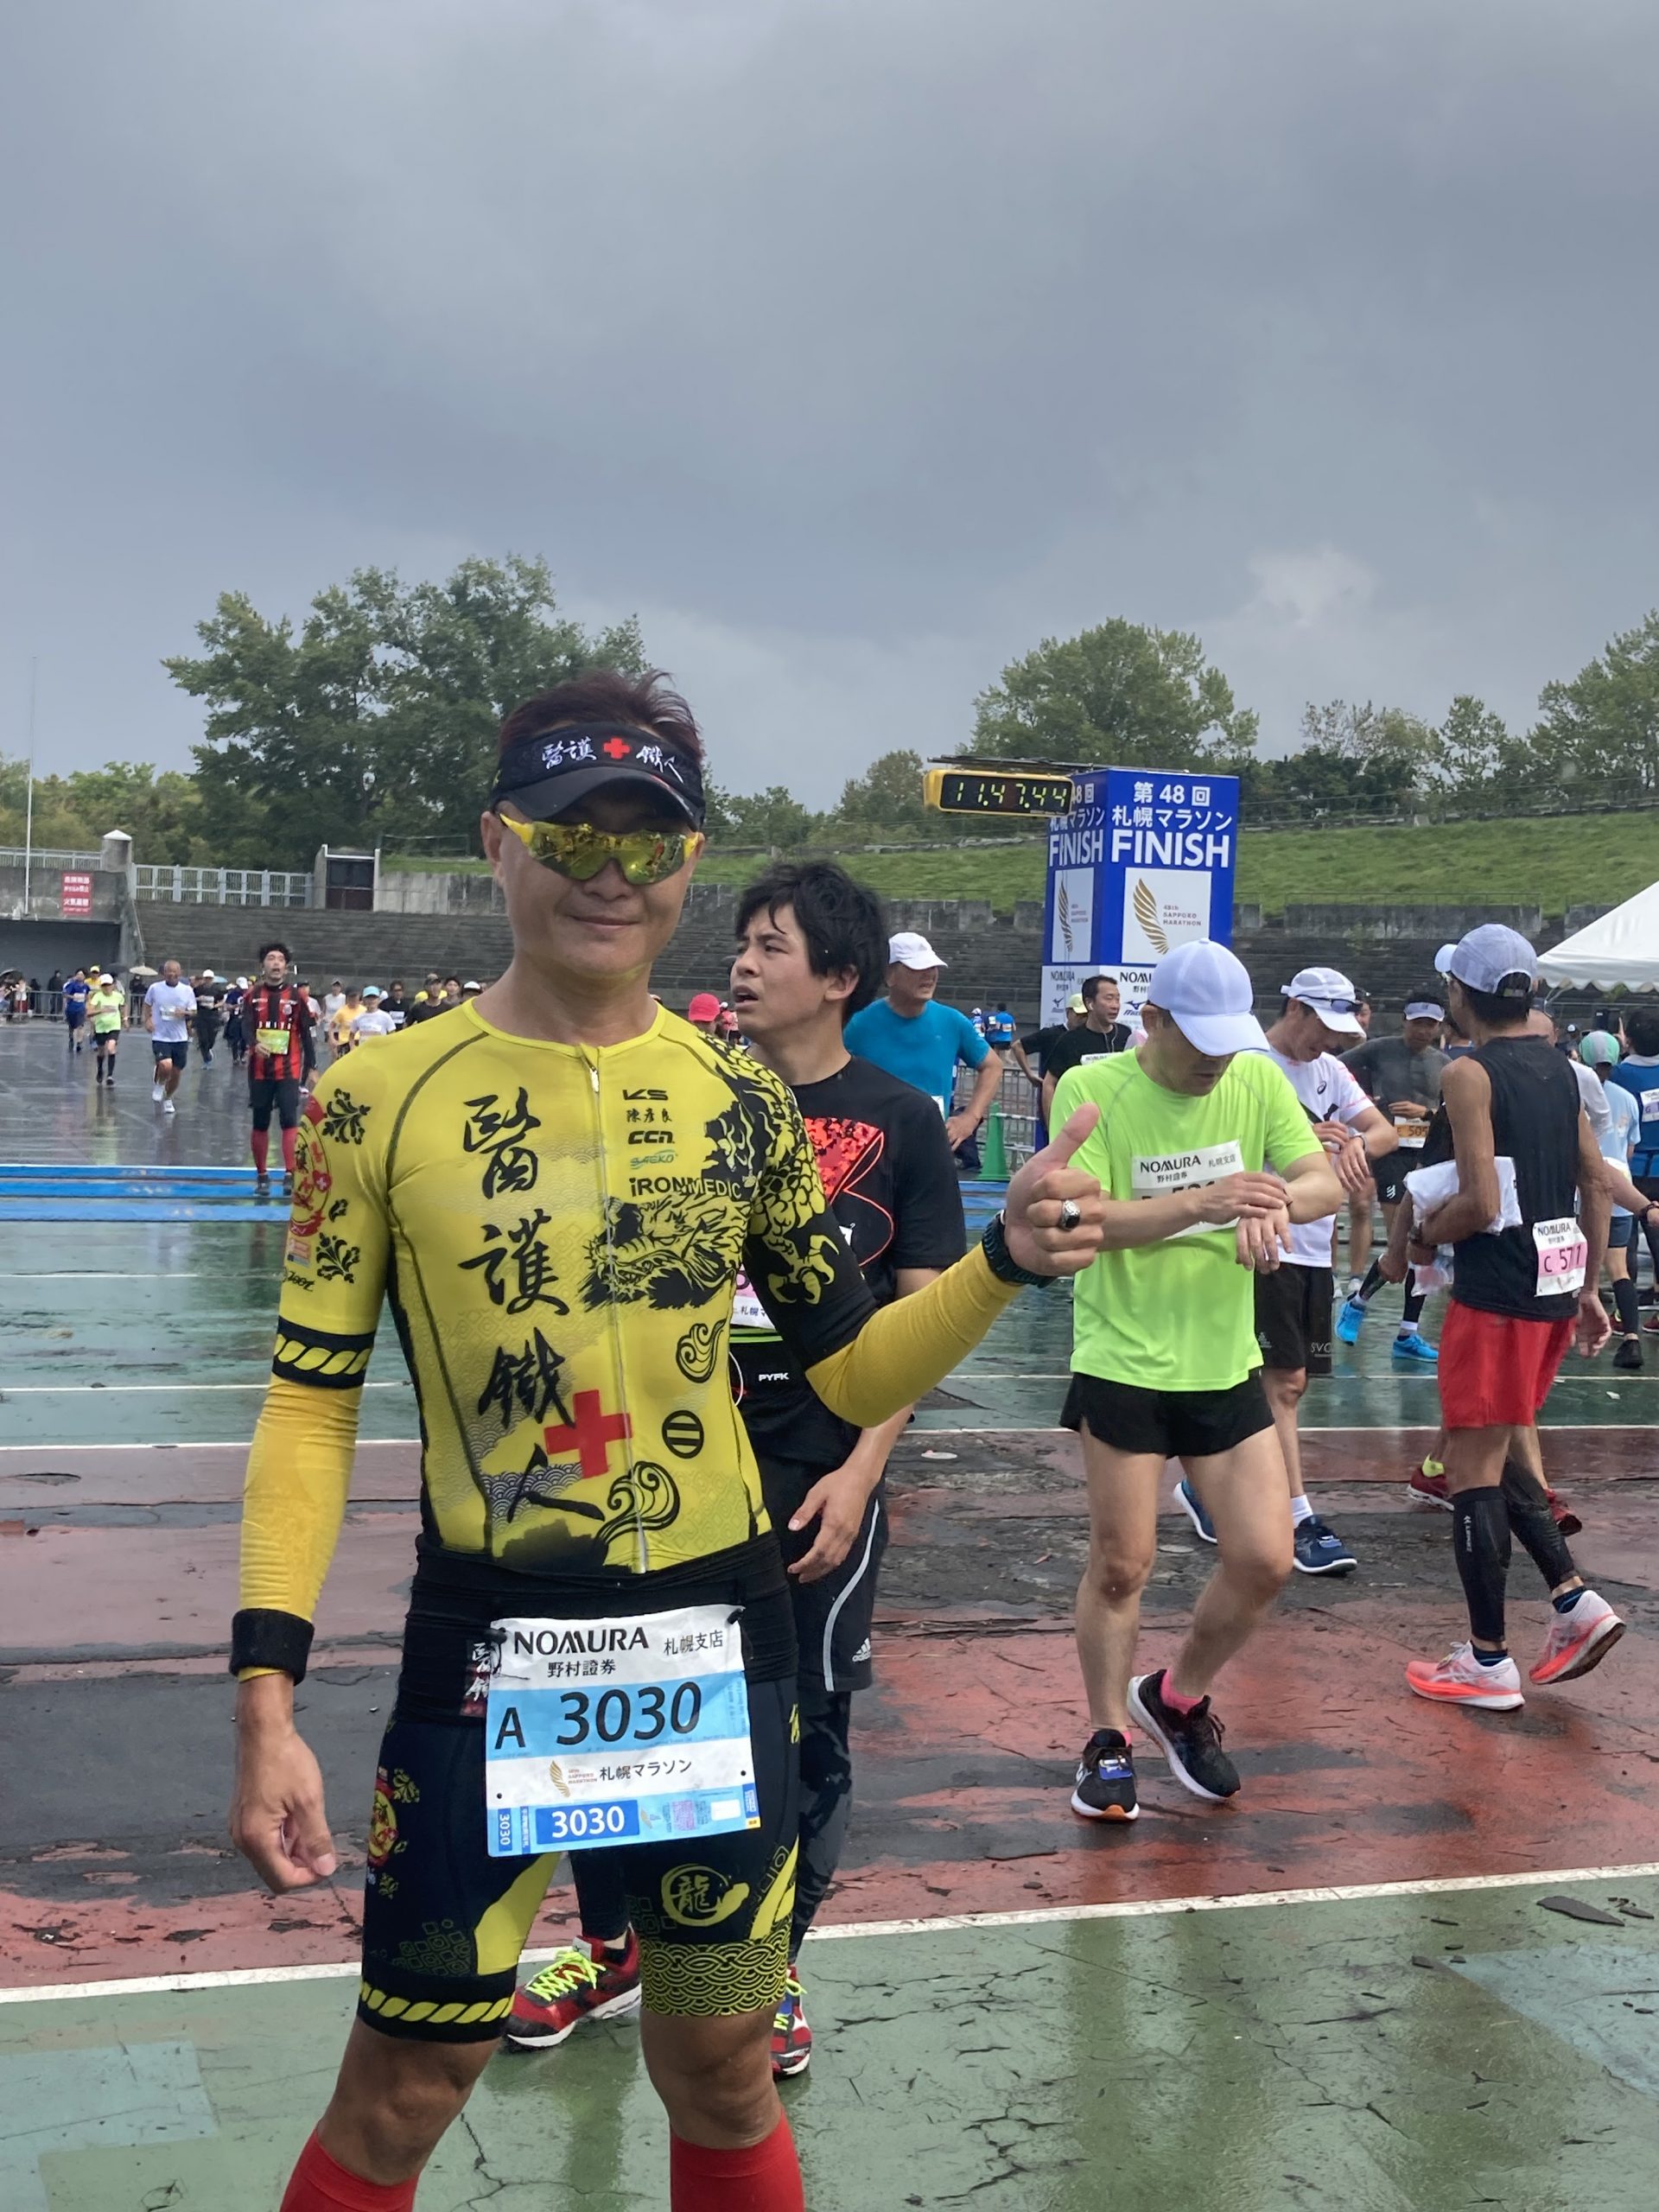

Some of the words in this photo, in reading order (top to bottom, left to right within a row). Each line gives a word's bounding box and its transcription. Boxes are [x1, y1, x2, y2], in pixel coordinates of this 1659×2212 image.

[1111, 804, 1232, 832] 札幌マラソン
[1048, 829, 1103, 868] FINISH
[1110, 829, 1230, 868] FINISH
[1119, 972, 1152, 983] NOM
[1140, 1154, 1202, 1173] NOMURA
[1538, 1223, 1572, 1236] NOMURA
[1544, 1255, 1553, 1273] C
[513, 1625, 650, 1656] NOMURA
[663, 1628, 724, 1656] 札幌支店
[547, 1659, 617, 1679] 野村證券
[494, 1706, 526, 1751] A
[556, 1681, 702, 1746] 3030
[599, 1758, 693, 1782] 札幌マラソン
[499, 1813, 512, 1847] 3030
[551, 1805, 626, 1839] 3030
